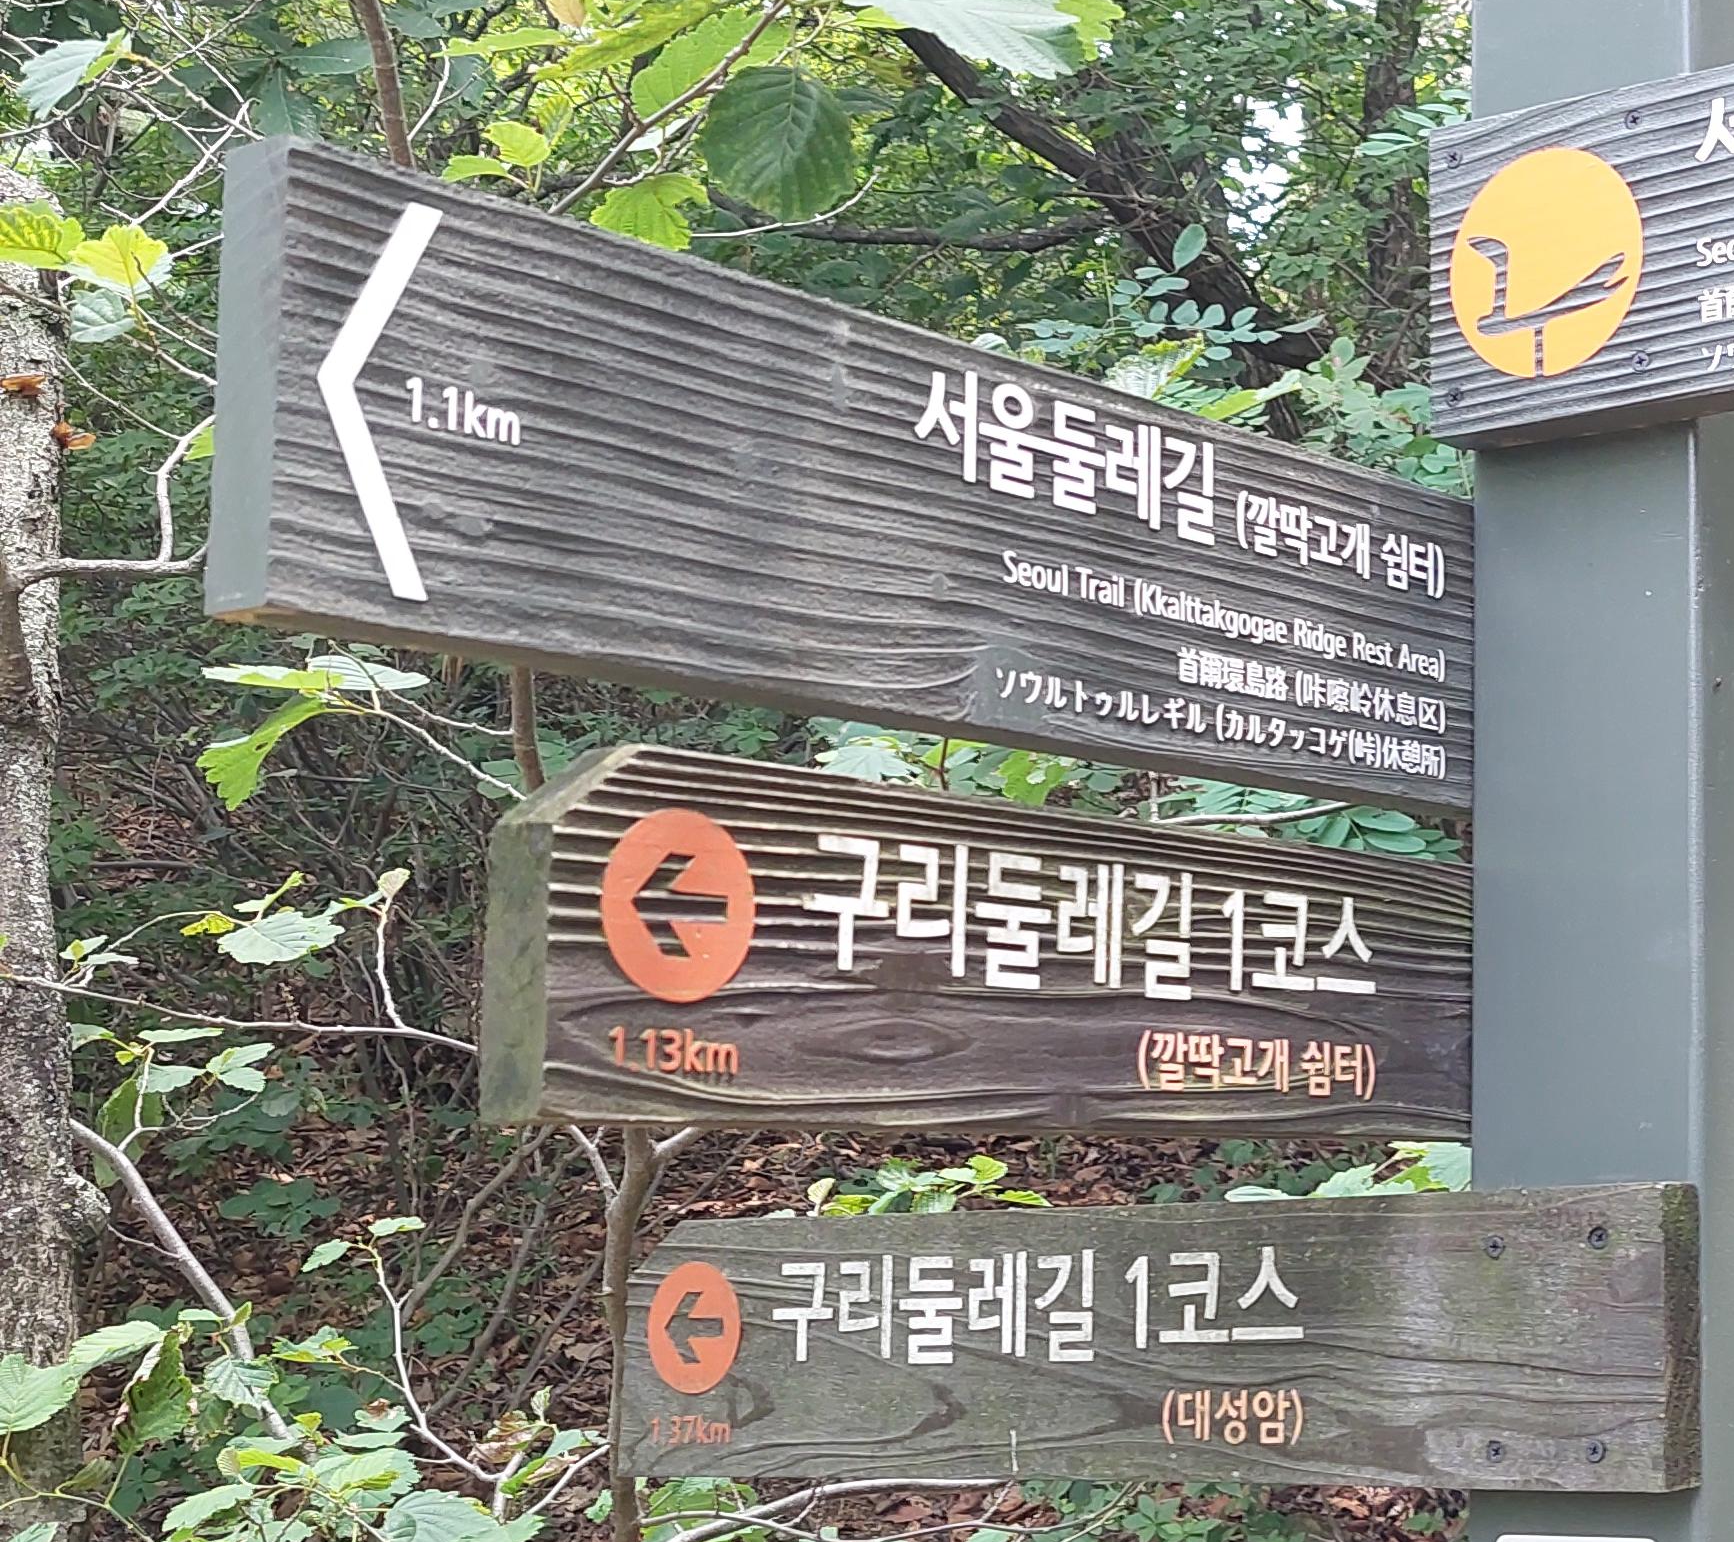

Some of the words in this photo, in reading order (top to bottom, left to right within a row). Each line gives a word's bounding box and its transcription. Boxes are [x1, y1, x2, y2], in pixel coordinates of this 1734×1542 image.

[406, 376, 521, 446] 1.1km
[913, 369, 1216, 546] 서울둘레길
[1236, 489, 1371, 580] (깔딱고개
[1380, 532, 1446, 600] 쉼터)
[1002, 550, 1069, 596] Seoul
[1075, 566, 1125, 609] Trail
[1133, 576, 1288, 645] (Kkalttakgogae
[1293, 617, 1348, 660] Ridge
[1351, 632, 1393, 666] Rest
[1397, 643, 1446, 683] Area)
[994, 666, 1207, 733] ソウルトゥルレギル
[1177, 646, 1290, 702] 首爾環島路
[803, 833, 1194, 1000] 구리둘레길
[1219, 889, 1377, 995] 1코스
[608, 1025, 738, 1075] 1.13km
[1137, 1029, 1290, 1093] (깔딱고개
[1302, 1040, 1376, 1100] 쉼터)
[772, 1248, 1095, 1365] 구리둘레길
[1124, 1246, 1304, 1349] 1코스
[1161, 1387, 1304, 1446] (대성암)
